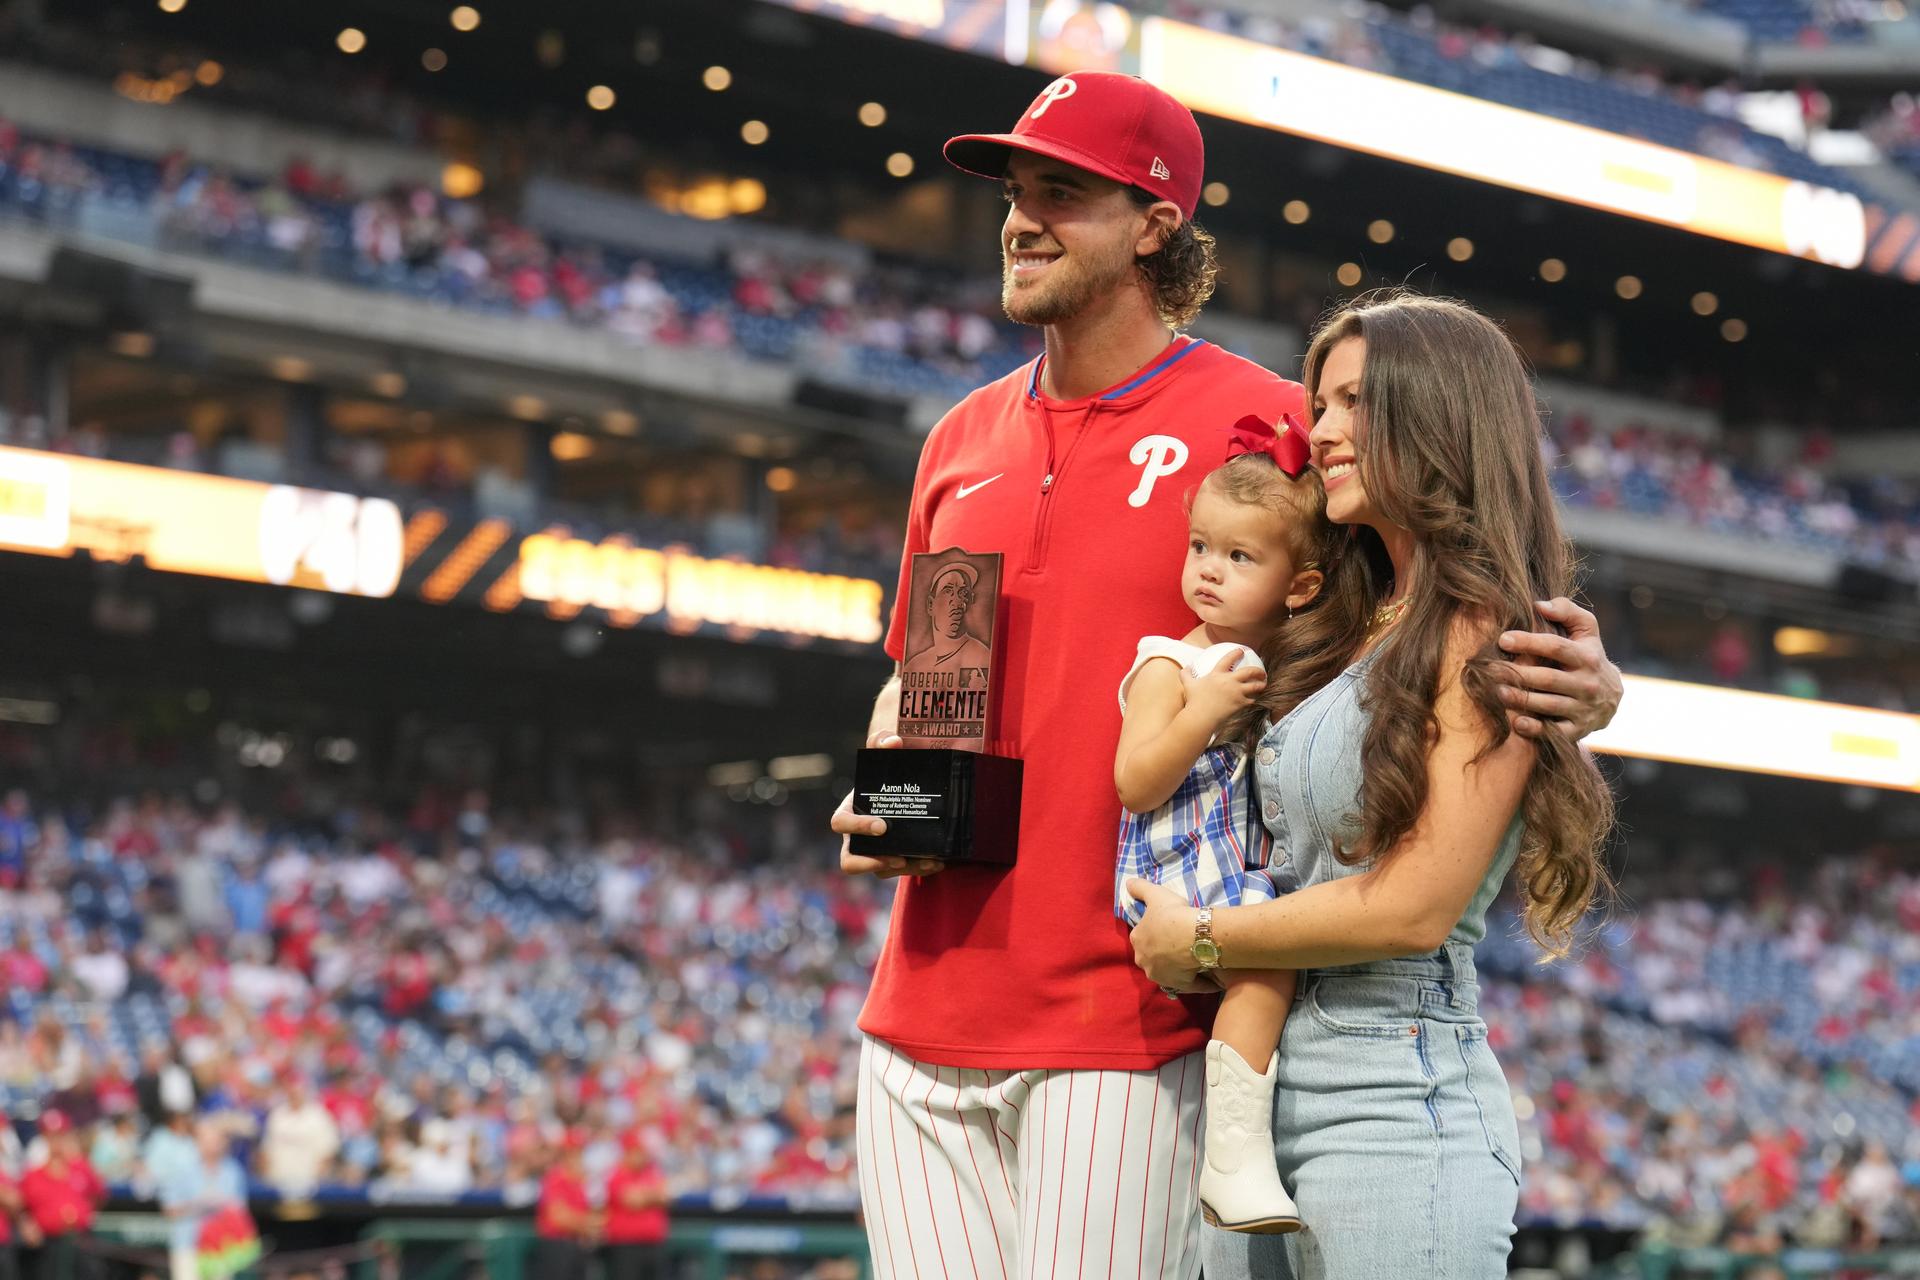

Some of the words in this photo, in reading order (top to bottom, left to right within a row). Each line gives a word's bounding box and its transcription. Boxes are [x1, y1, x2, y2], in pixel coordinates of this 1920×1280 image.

[1030, 78, 1077, 119] P
[1128, 434, 1189, 508] P
[902, 672, 953, 688] ROBERTO
[900, 690, 987, 719] CLEMENTE
[922, 723, 960, 736] AWARD
[880, 784, 902, 792] Aaron
[904, 784, 920, 793] Nola
